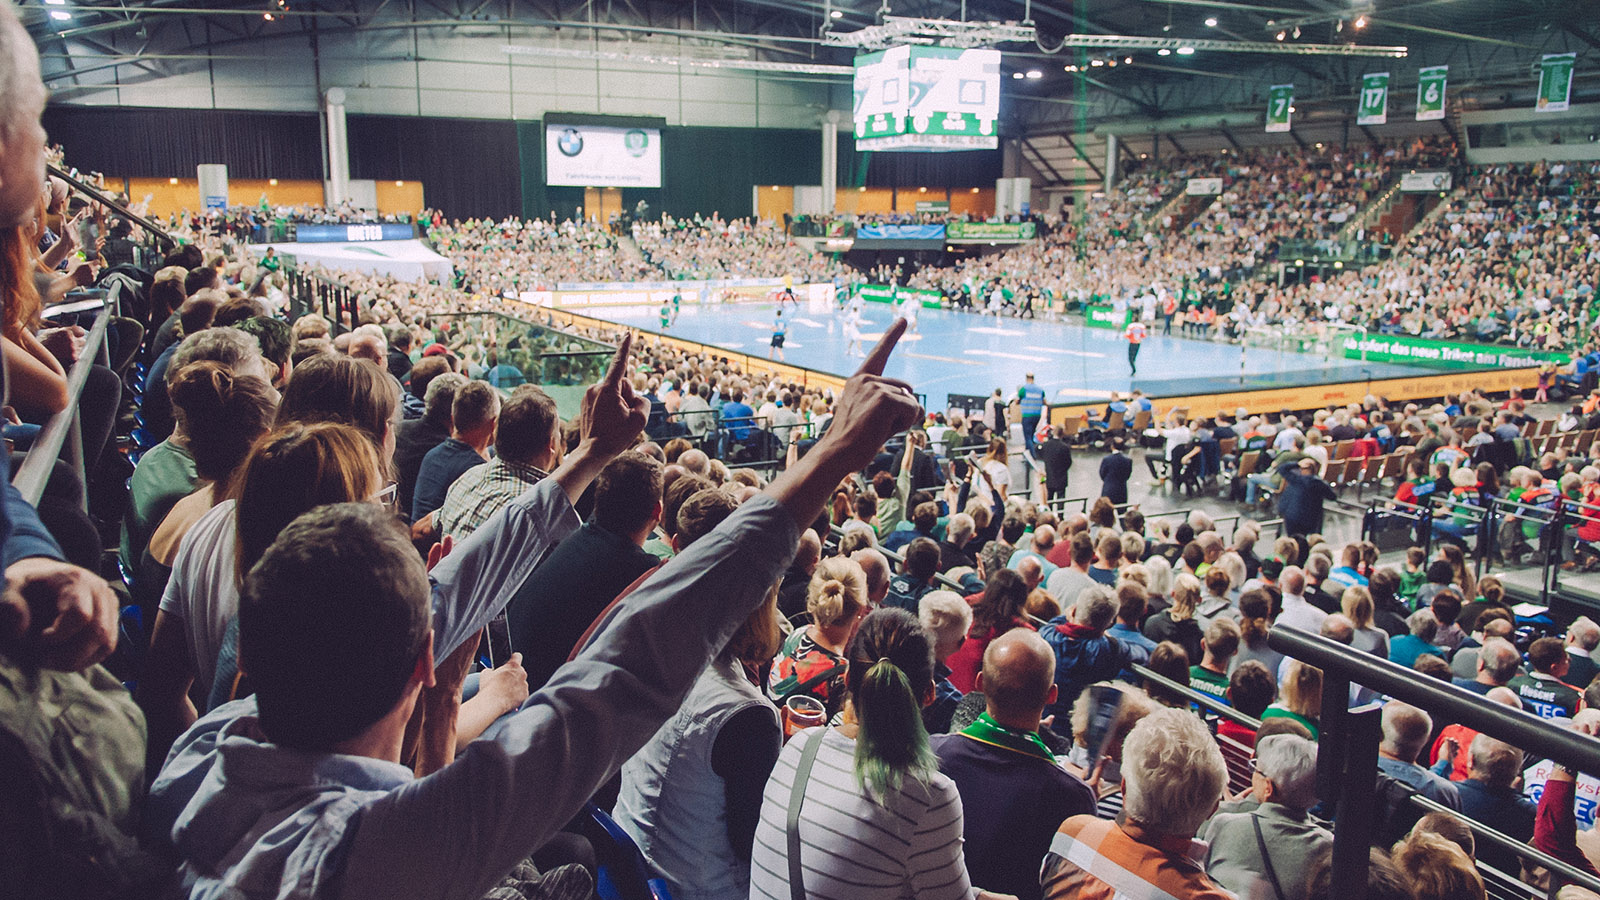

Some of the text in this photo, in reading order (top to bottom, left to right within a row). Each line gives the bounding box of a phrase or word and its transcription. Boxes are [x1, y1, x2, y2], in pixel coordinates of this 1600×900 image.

[1366, 88, 1384, 108] 17
[1425, 82, 1439, 103] 6
[1275, 98, 1286, 117] 7
[1343, 337, 1357, 350] Ab
[1358, 338, 1389, 354] sofort
[1390, 342, 1409, 356] das
[1411, 346, 1439, 359] neue
[1476, 353, 1496, 365] am
